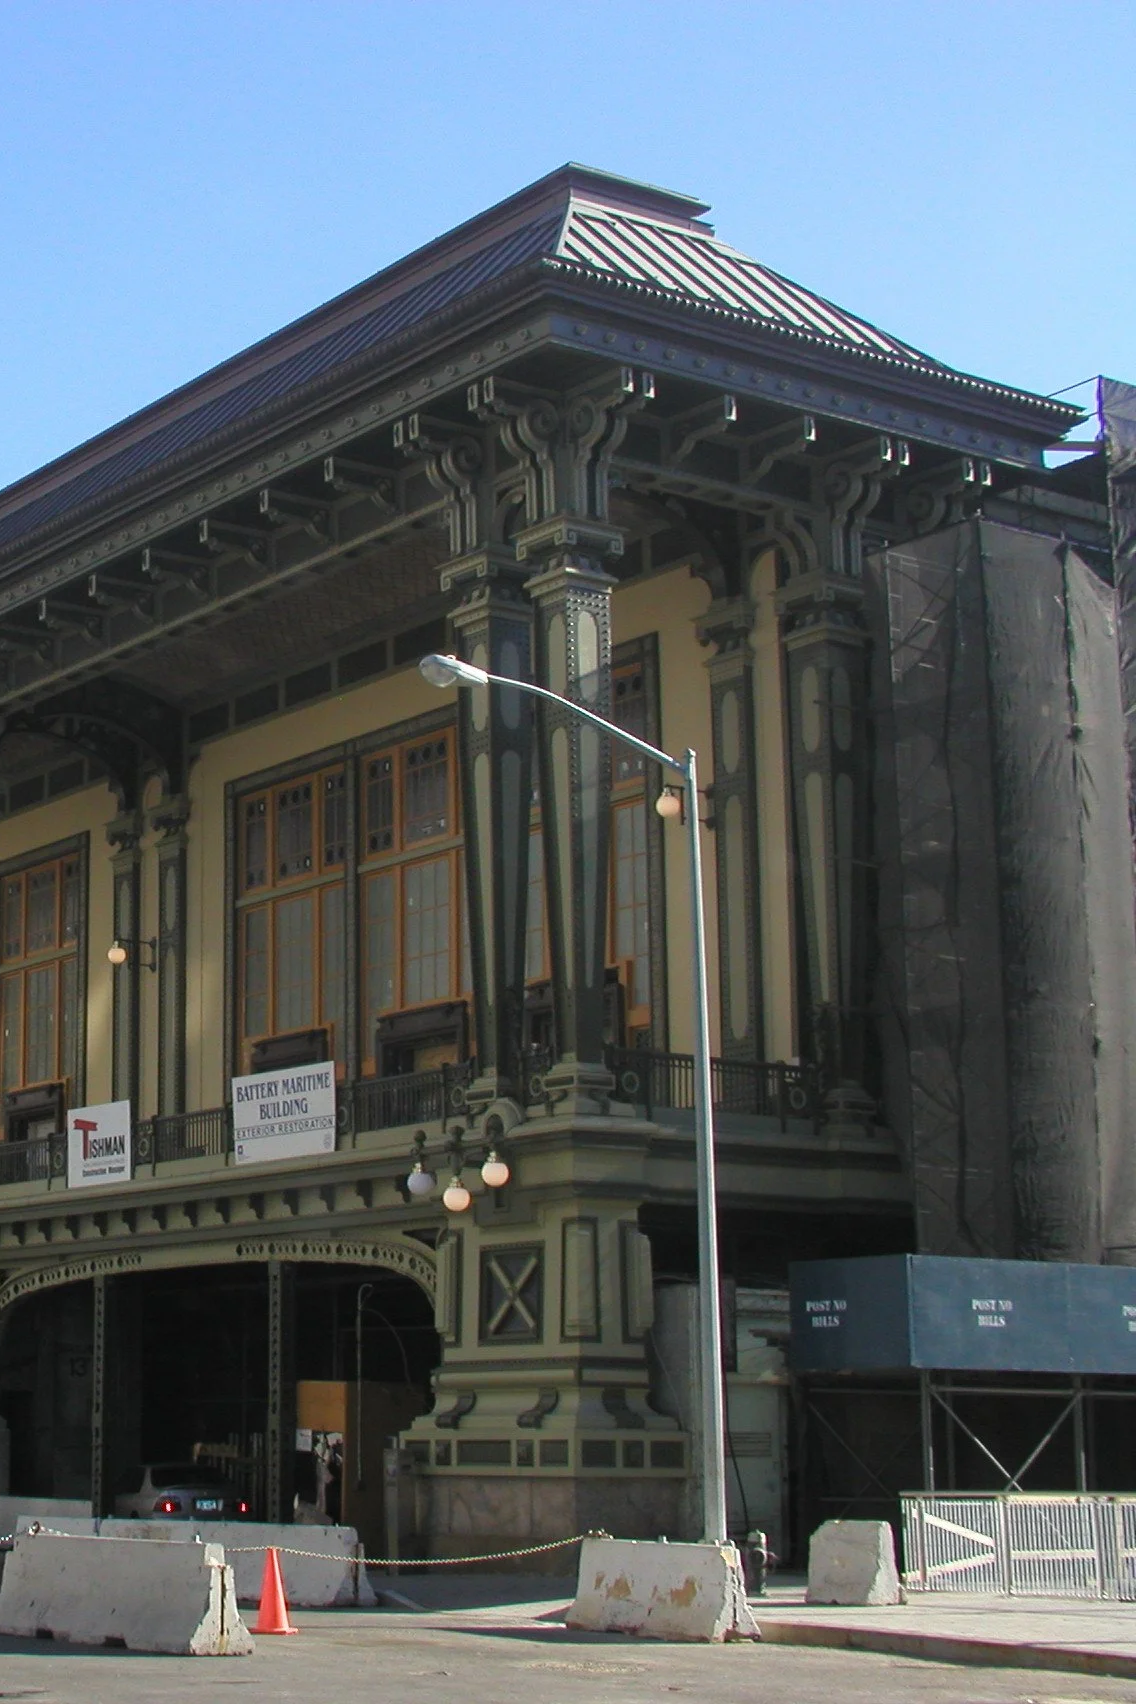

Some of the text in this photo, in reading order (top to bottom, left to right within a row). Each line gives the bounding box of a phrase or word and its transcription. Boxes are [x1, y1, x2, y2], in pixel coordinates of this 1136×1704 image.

[236, 1072, 330, 1102] BATTERY MARITIME
[259, 1097, 308, 1120] BUILDING
[237, 1118, 334, 1139] EXTERIOR RESTORATION
[73, 1118, 125, 1161] TISHMAN
[806, 1299, 847, 1312] POST NO
[972, 1298, 1013, 1311] POST NO
[812, 1315, 840, 1328] BILLS
[977, 1314, 1006, 1328] BILLS
